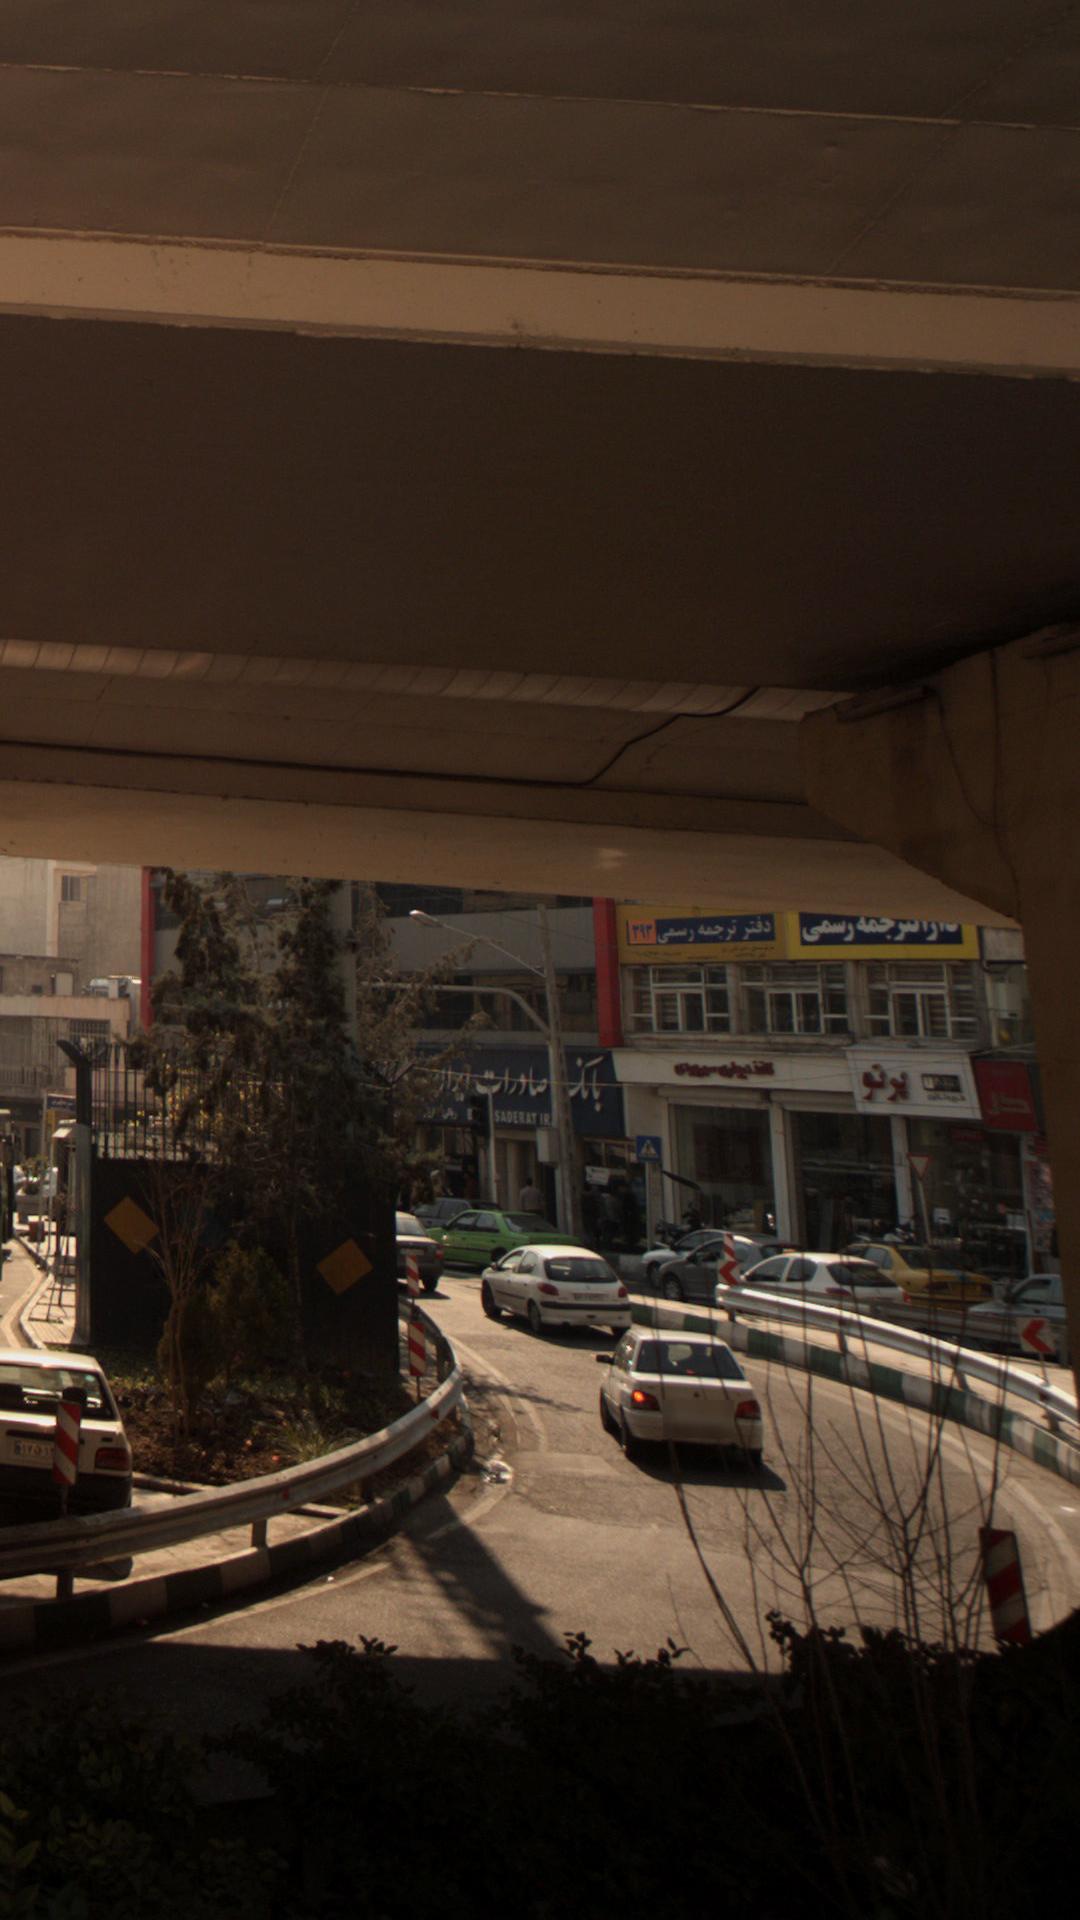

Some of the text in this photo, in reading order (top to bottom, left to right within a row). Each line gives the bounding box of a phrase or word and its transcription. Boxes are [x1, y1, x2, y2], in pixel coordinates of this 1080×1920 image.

[657, 916, 772, 944] دفتر ترجمه رسمی
[801, 918, 855, 942] رسمی
[494, 1108, 538, 1125] SADERAT
